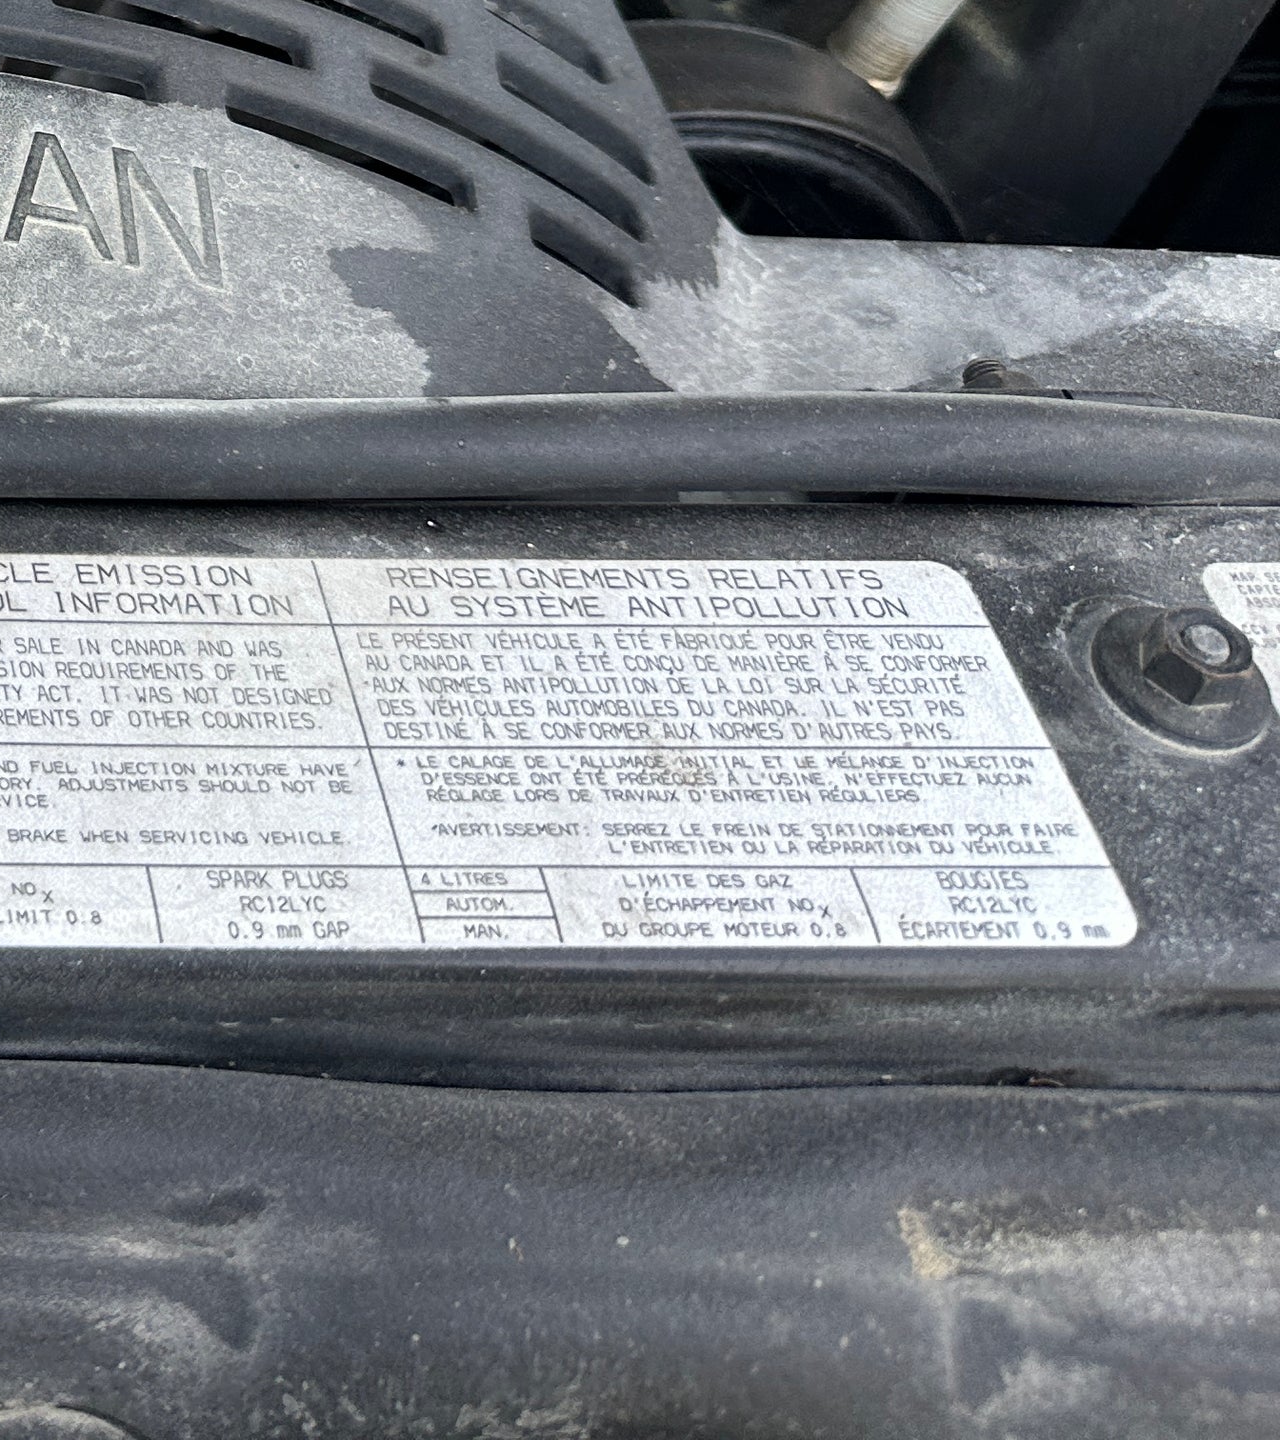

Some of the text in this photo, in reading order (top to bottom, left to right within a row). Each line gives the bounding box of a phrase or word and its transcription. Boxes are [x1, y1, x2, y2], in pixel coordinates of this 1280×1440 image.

[75, 564, 253, 586] EMISSION
[386, 568, 883, 590] RENSEIGNEMENTS RELATIFS
[54, 592, 294, 615] INFORMATION
[389, 589, 910, 618] AU SYSTÈME ANTIPOLLUTION
[14, 637, 64, 655] SALE
[77, 638, 101, 655] IN
[111, 639, 186, 656] CANADA
[198, 640, 234, 657] AND
[244, 641, 281, 658] WAS
[207, 867, 347, 890] SPARK PLUGS
[440, 872, 508, 886] LITRES
[622, 873, 792, 889] LIMITE DES GAZ
[935, 870, 1027, 890] BOUGIES
[239, 895, 325, 913] RC12LYC
[618, 889, 774, 913] D'ÉCHAPPEMENT
[948, 896, 1035, 914] RC12LYC
[227, 919, 350, 939] 0.9 mm GAP
[601, 922, 628, 938] DU
[638, 922, 714, 938] GROUPE
[723, 922, 800, 937] MOTEUR
[898, 912, 1022, 939] ÉCARTEMENT
